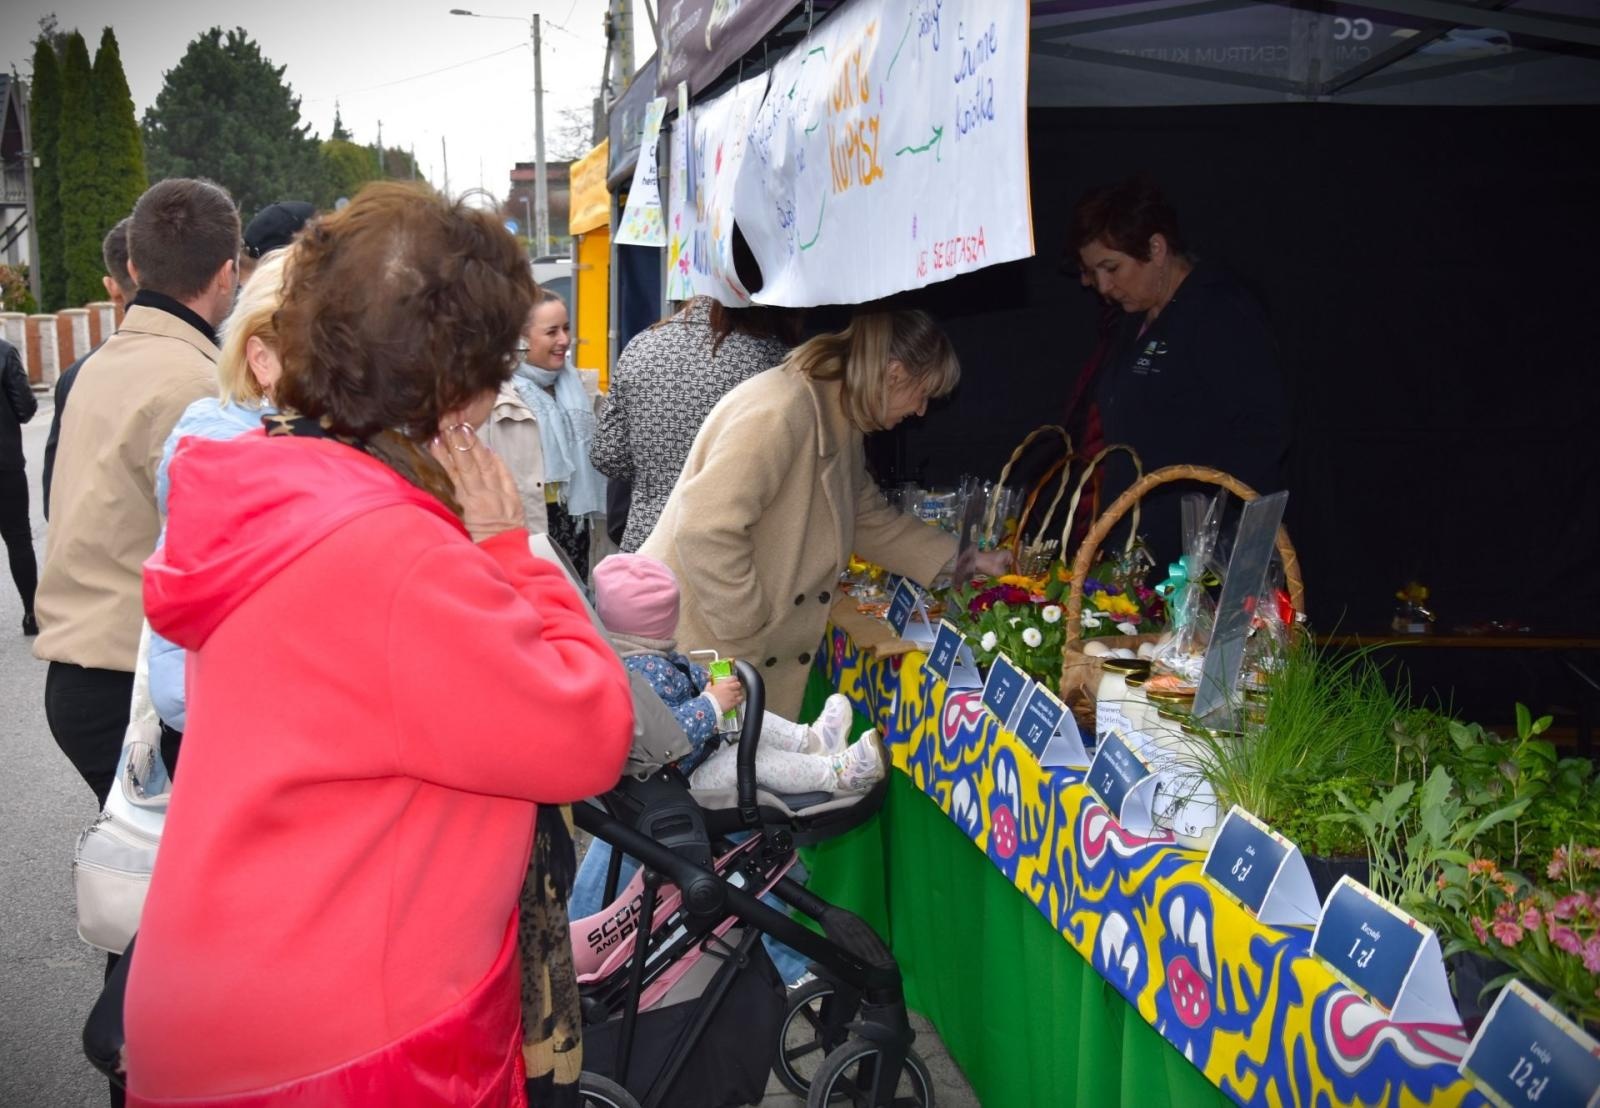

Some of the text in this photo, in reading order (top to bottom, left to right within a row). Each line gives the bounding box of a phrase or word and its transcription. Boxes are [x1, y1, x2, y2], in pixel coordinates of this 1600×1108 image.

[1231, 855, 1253, 882] 8 zł
[595, 934, 619, 955] AND
[1346, 938, 1377, 969] 1 zł
[1508, 1055, 1551, 1103] 12 zł
